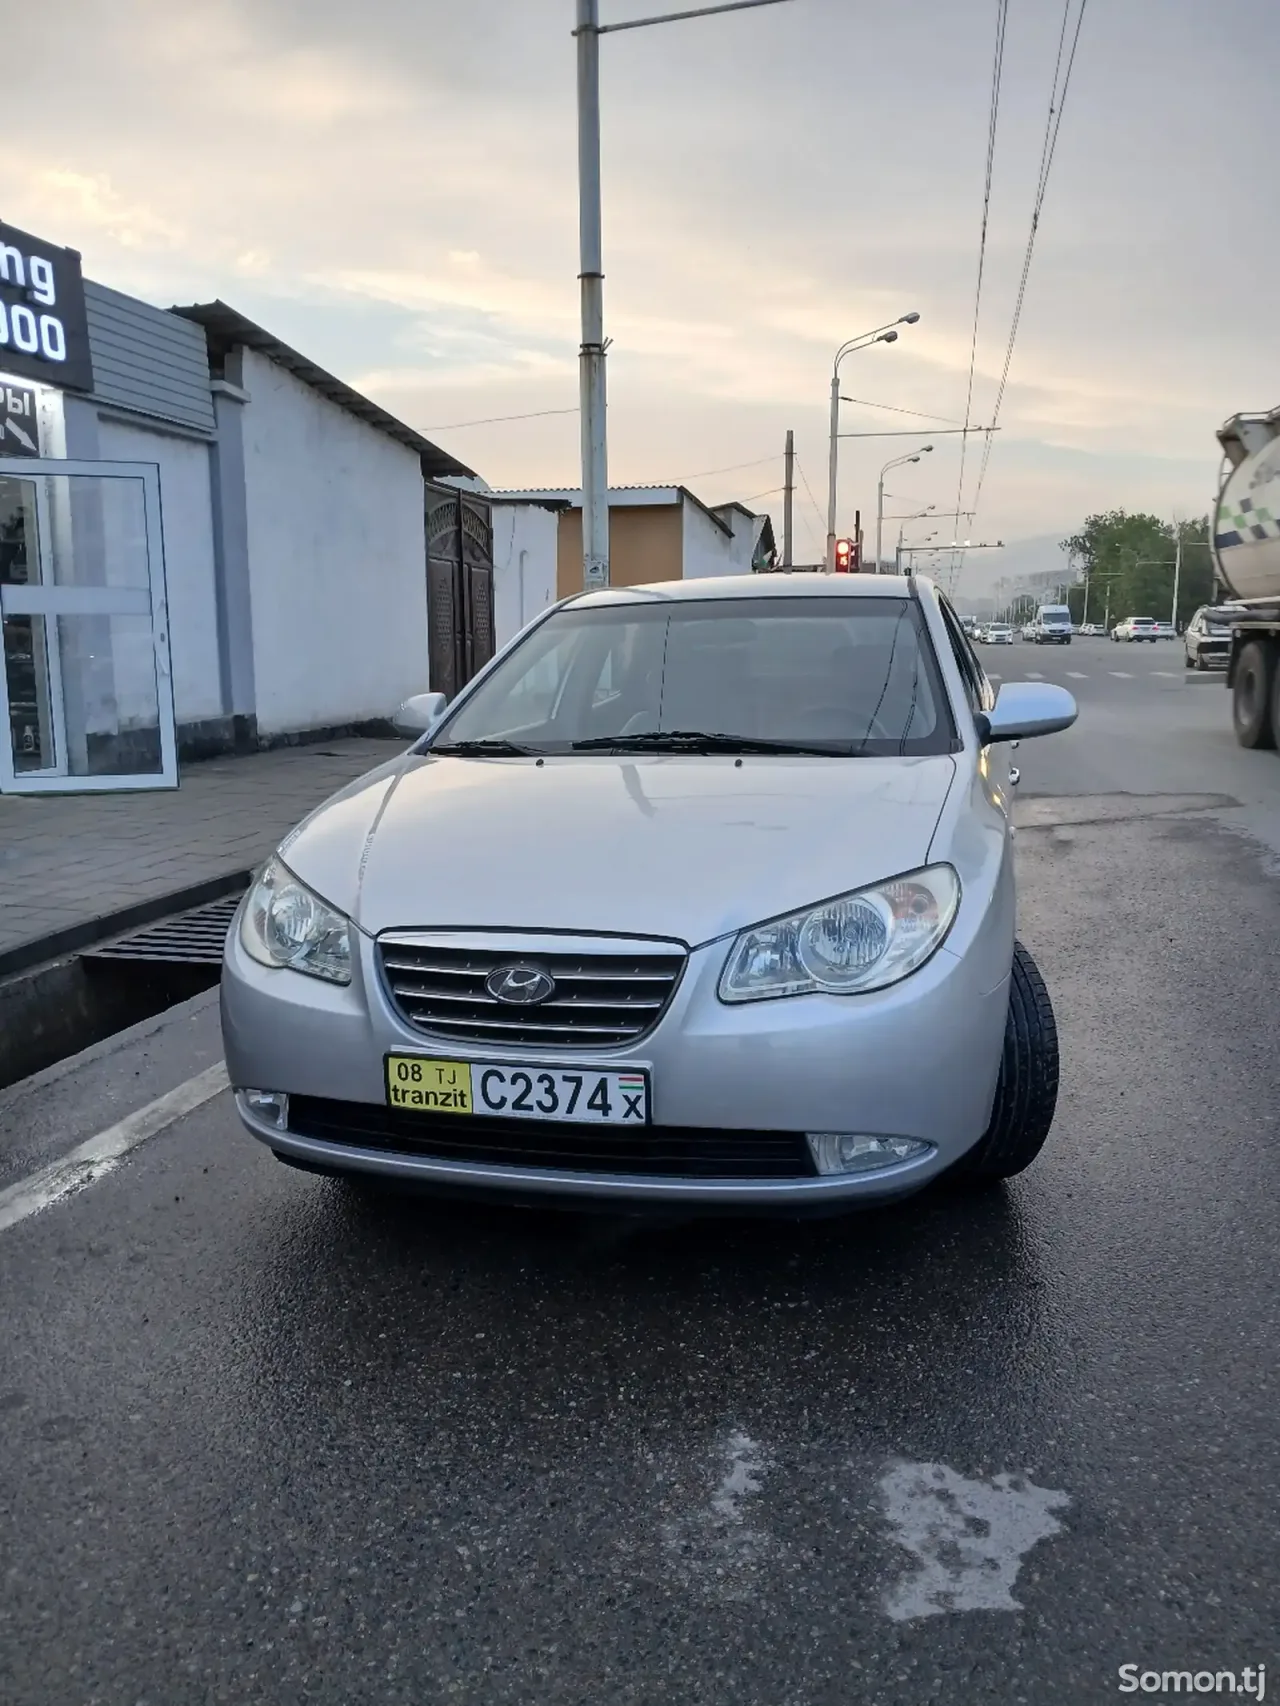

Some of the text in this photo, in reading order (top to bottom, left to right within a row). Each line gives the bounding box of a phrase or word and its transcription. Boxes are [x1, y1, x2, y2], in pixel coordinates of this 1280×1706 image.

[397, 1062, 456, 1085] 08 TJ
[391, 1084, 467, 1108] tranzit
[481, 1069, 612, 1117] C2374
